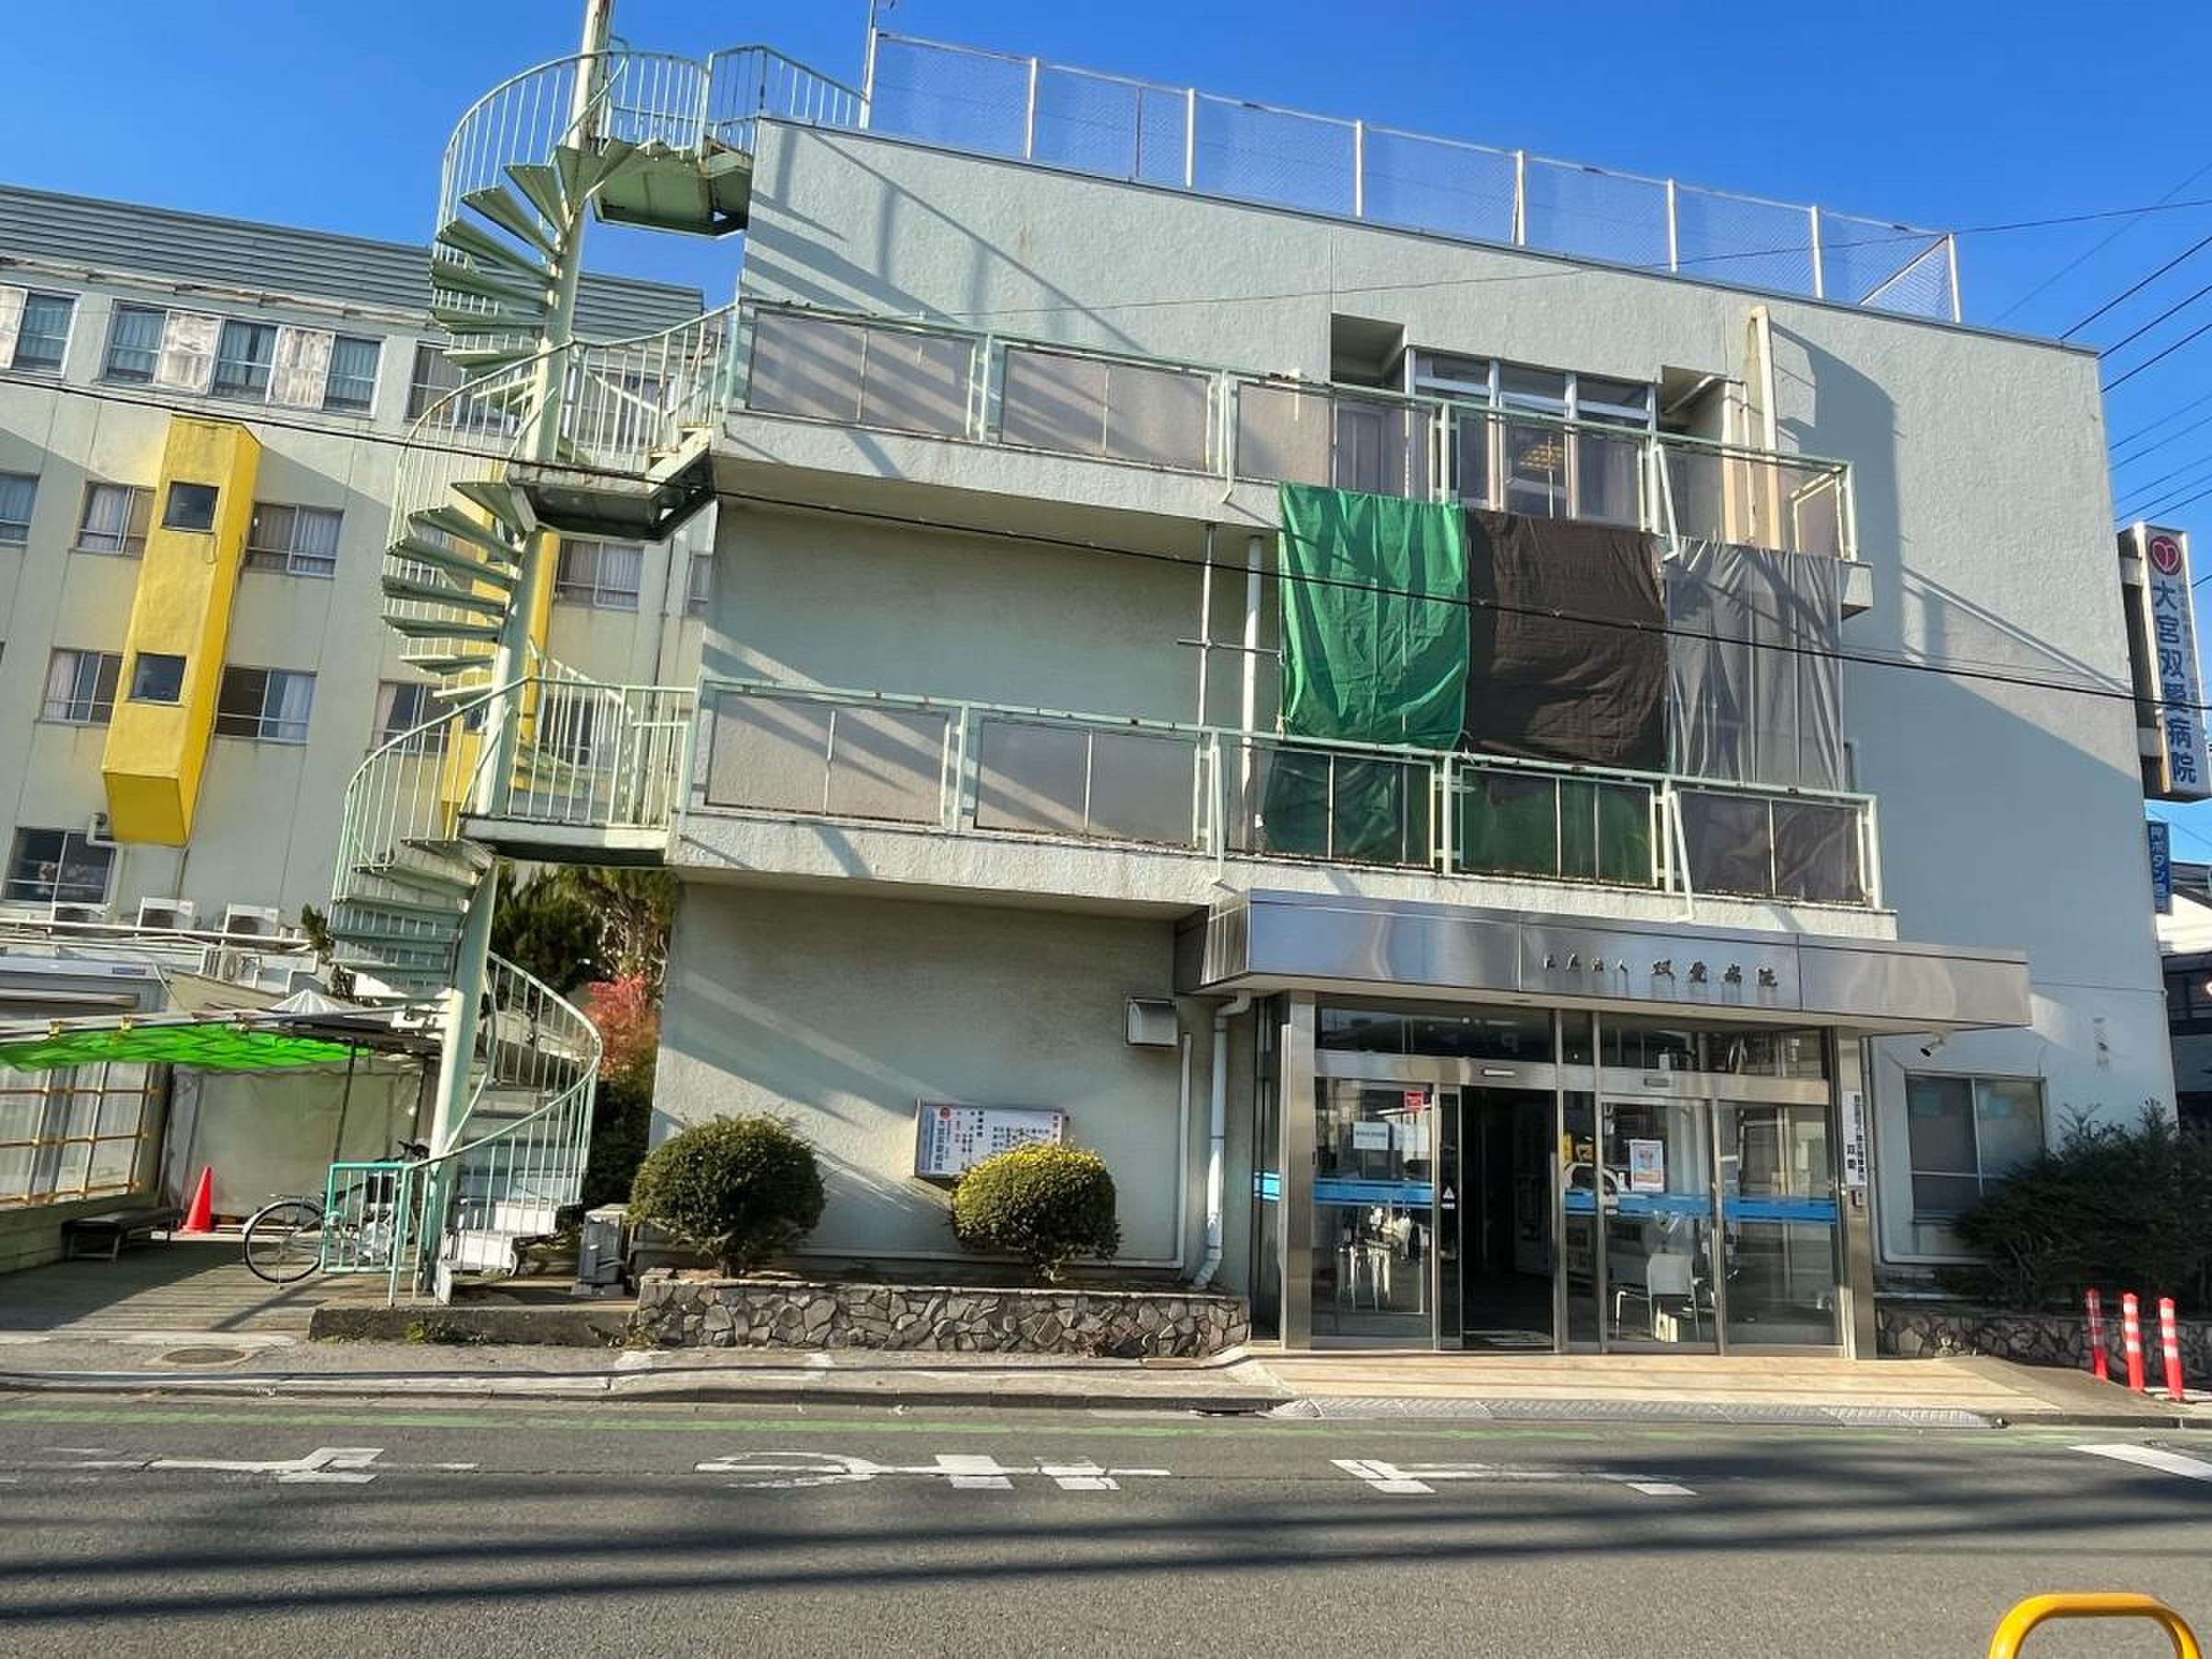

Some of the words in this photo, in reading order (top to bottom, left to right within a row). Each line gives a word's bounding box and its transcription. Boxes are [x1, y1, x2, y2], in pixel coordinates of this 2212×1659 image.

[2151, 581, 2197, 784] 大宮双愛病院
